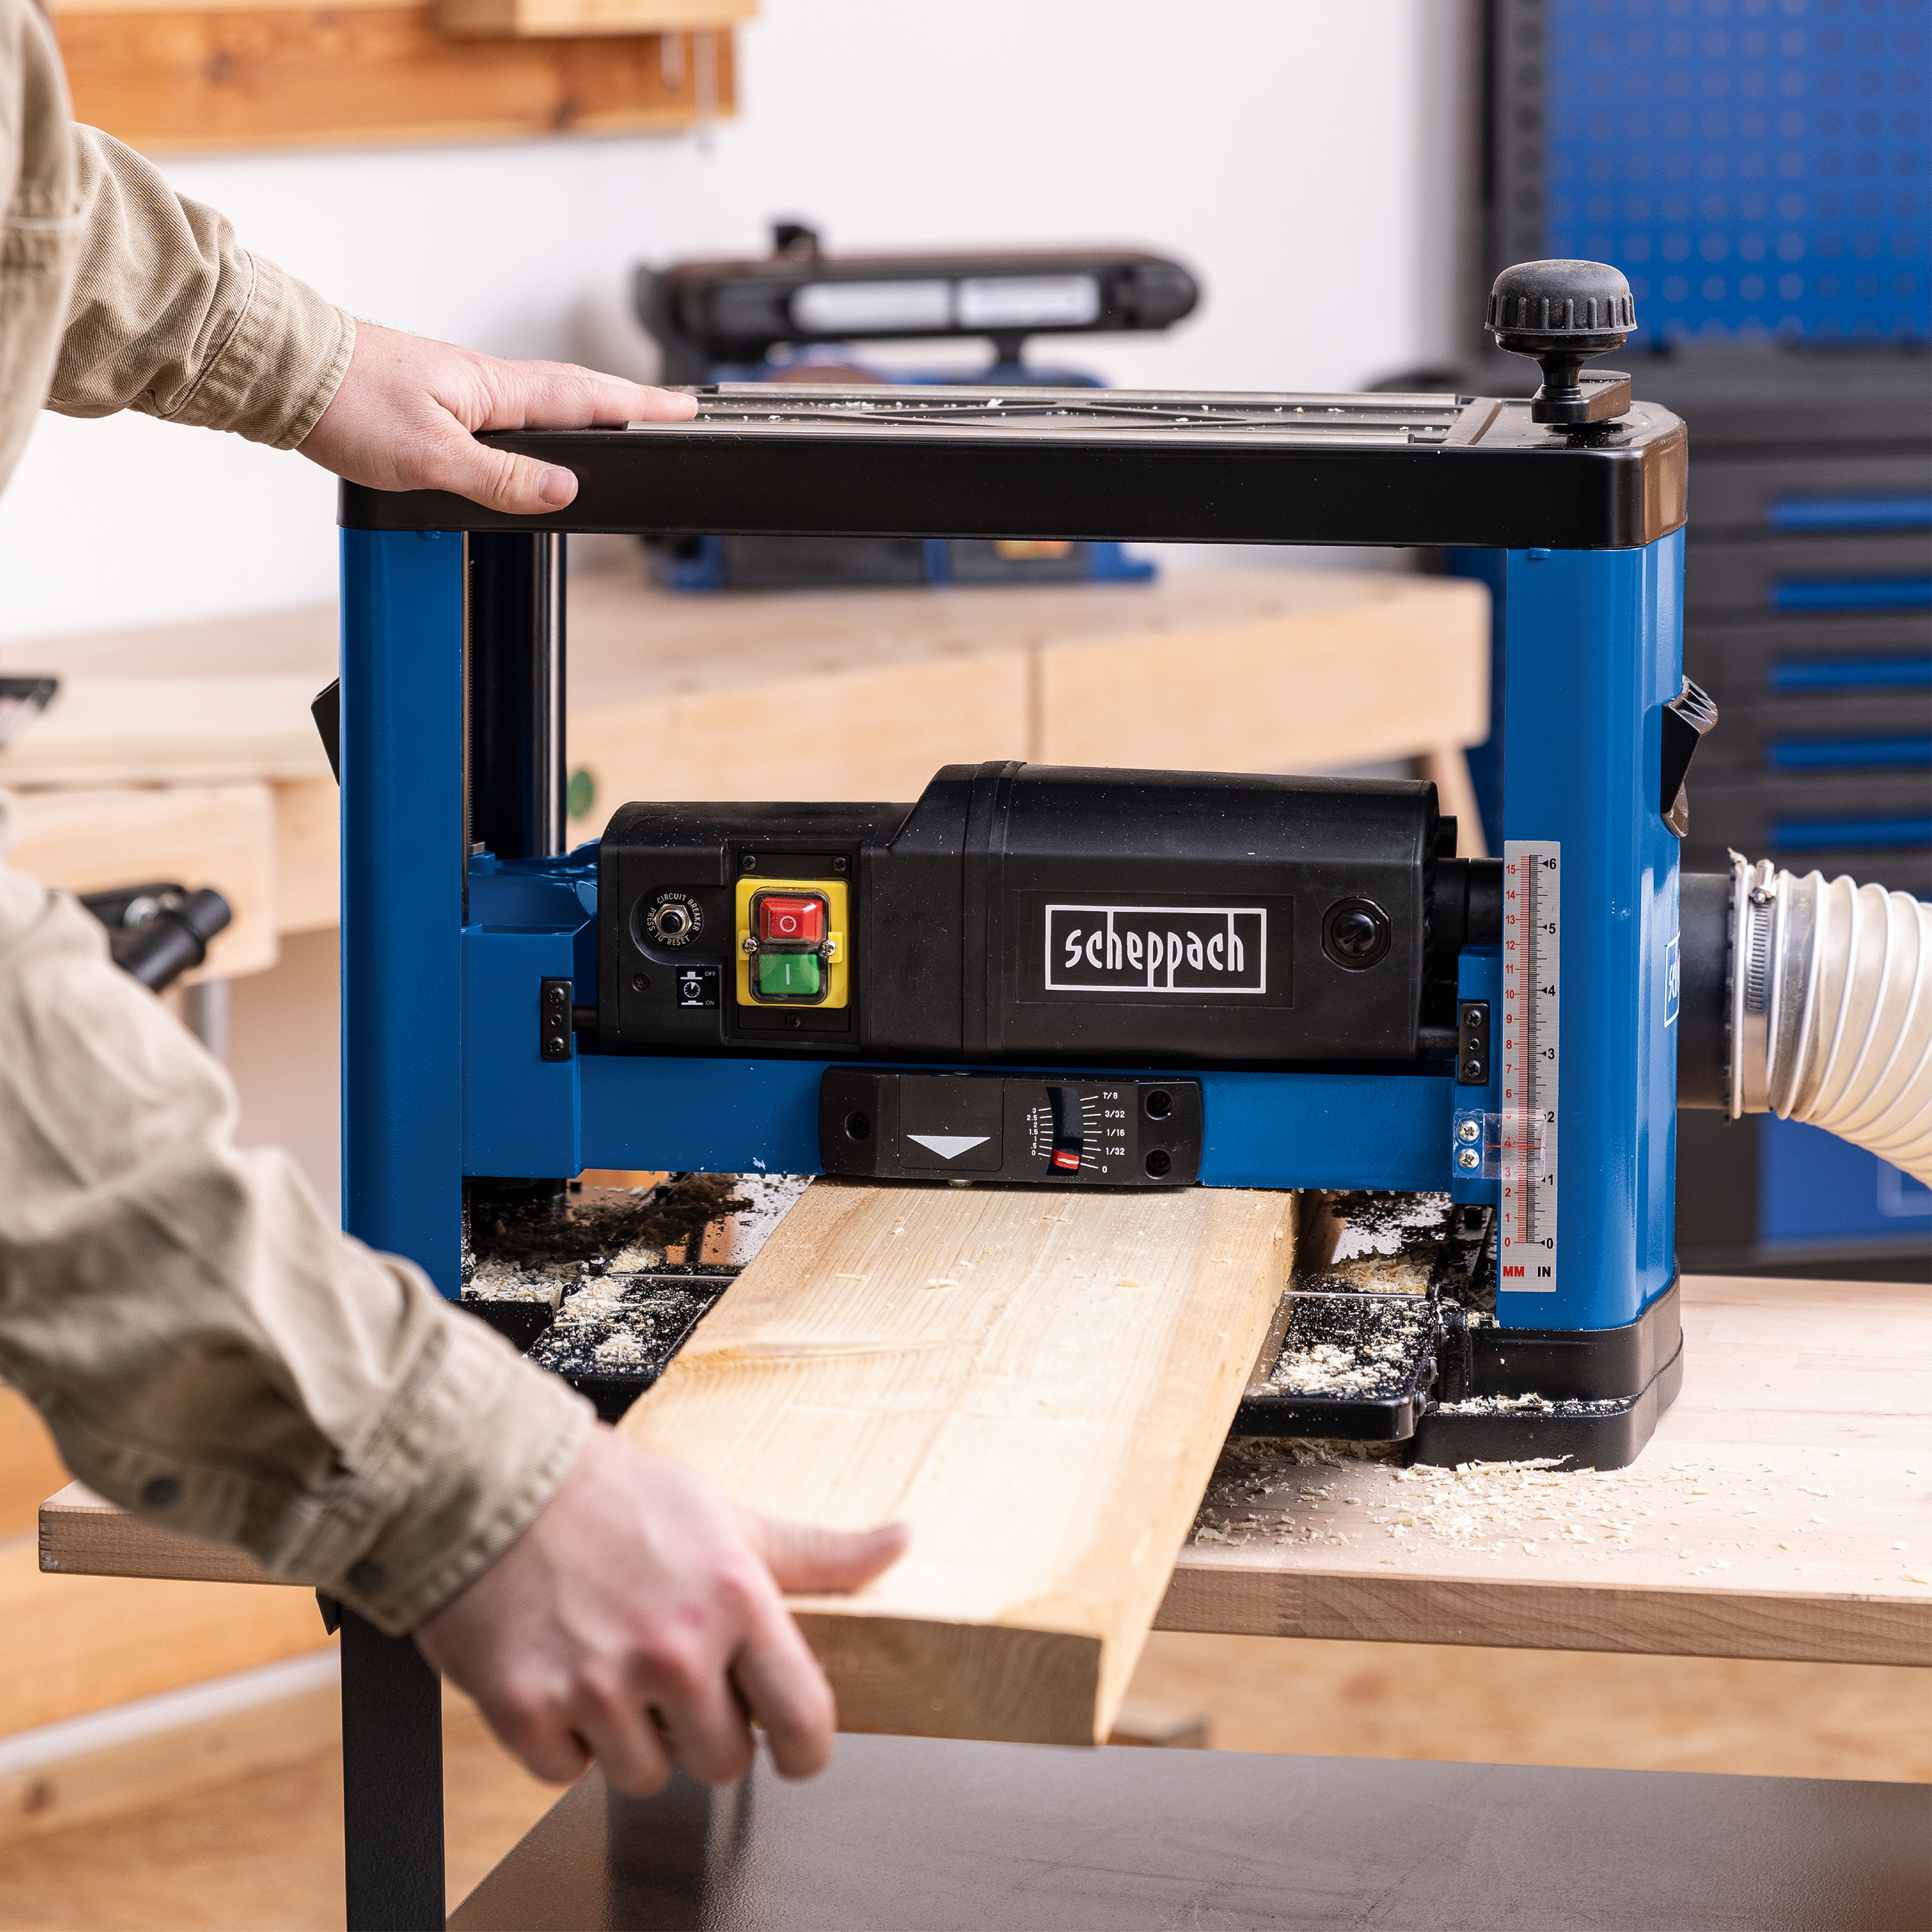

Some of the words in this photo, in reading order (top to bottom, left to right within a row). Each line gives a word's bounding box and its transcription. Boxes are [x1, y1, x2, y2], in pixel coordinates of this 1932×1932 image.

[1506, 864, 1516, 875] 15
[1549, 858, 1557, 870] 6
[1506, 889, 1516, 900] 14
[657, 893, 687, 904] CIRCUIT
[687, 898, 701, 931] BREAKER
[1506, 914, 1516, 925] 13
[647, 907, 657, 931] PRESS
[667, 934, 690, 946] RESET
[1548, 922, 1557, 934] 5
[1065, 905, 1244, 990] scheppach
[1506, 940, 1515, 950] 12
[1505, 964, 1514, 974] 11
[1505, 989, 1515, 999] 10
[1548, 985, 1556, 996] 4
[1506, 1014, 1513, 1024] 9
[1506, 1039, 1512, 1049] 8
[1548, 1048, 1555, 1060] 3
[1506, 1064, 1512, 1074] 7
[1505, 1088, 1512, 1099] 6
[1104, 1110, 1125, 1118] 3/32
[1547, 1111, 1555, 1122] 2
[1106, 1128, 1125, 1137] 1/16
[1105, 1147, 1125, 1155] 1/32
[1504, 1166, 1511, 1177] 3
[1548, 1174, 1553, 1185] 1
[1504, 1188, 1511, 1198] 2
[1505, 1213, 1510, 1222] 1
[1504, 1237, 1511, 1247] 0
[1546, 1238, 1553, 1249] 0
[1502, 1266, 1525, 1278] MM
[1537, 1266, 1551, 1278] IN
